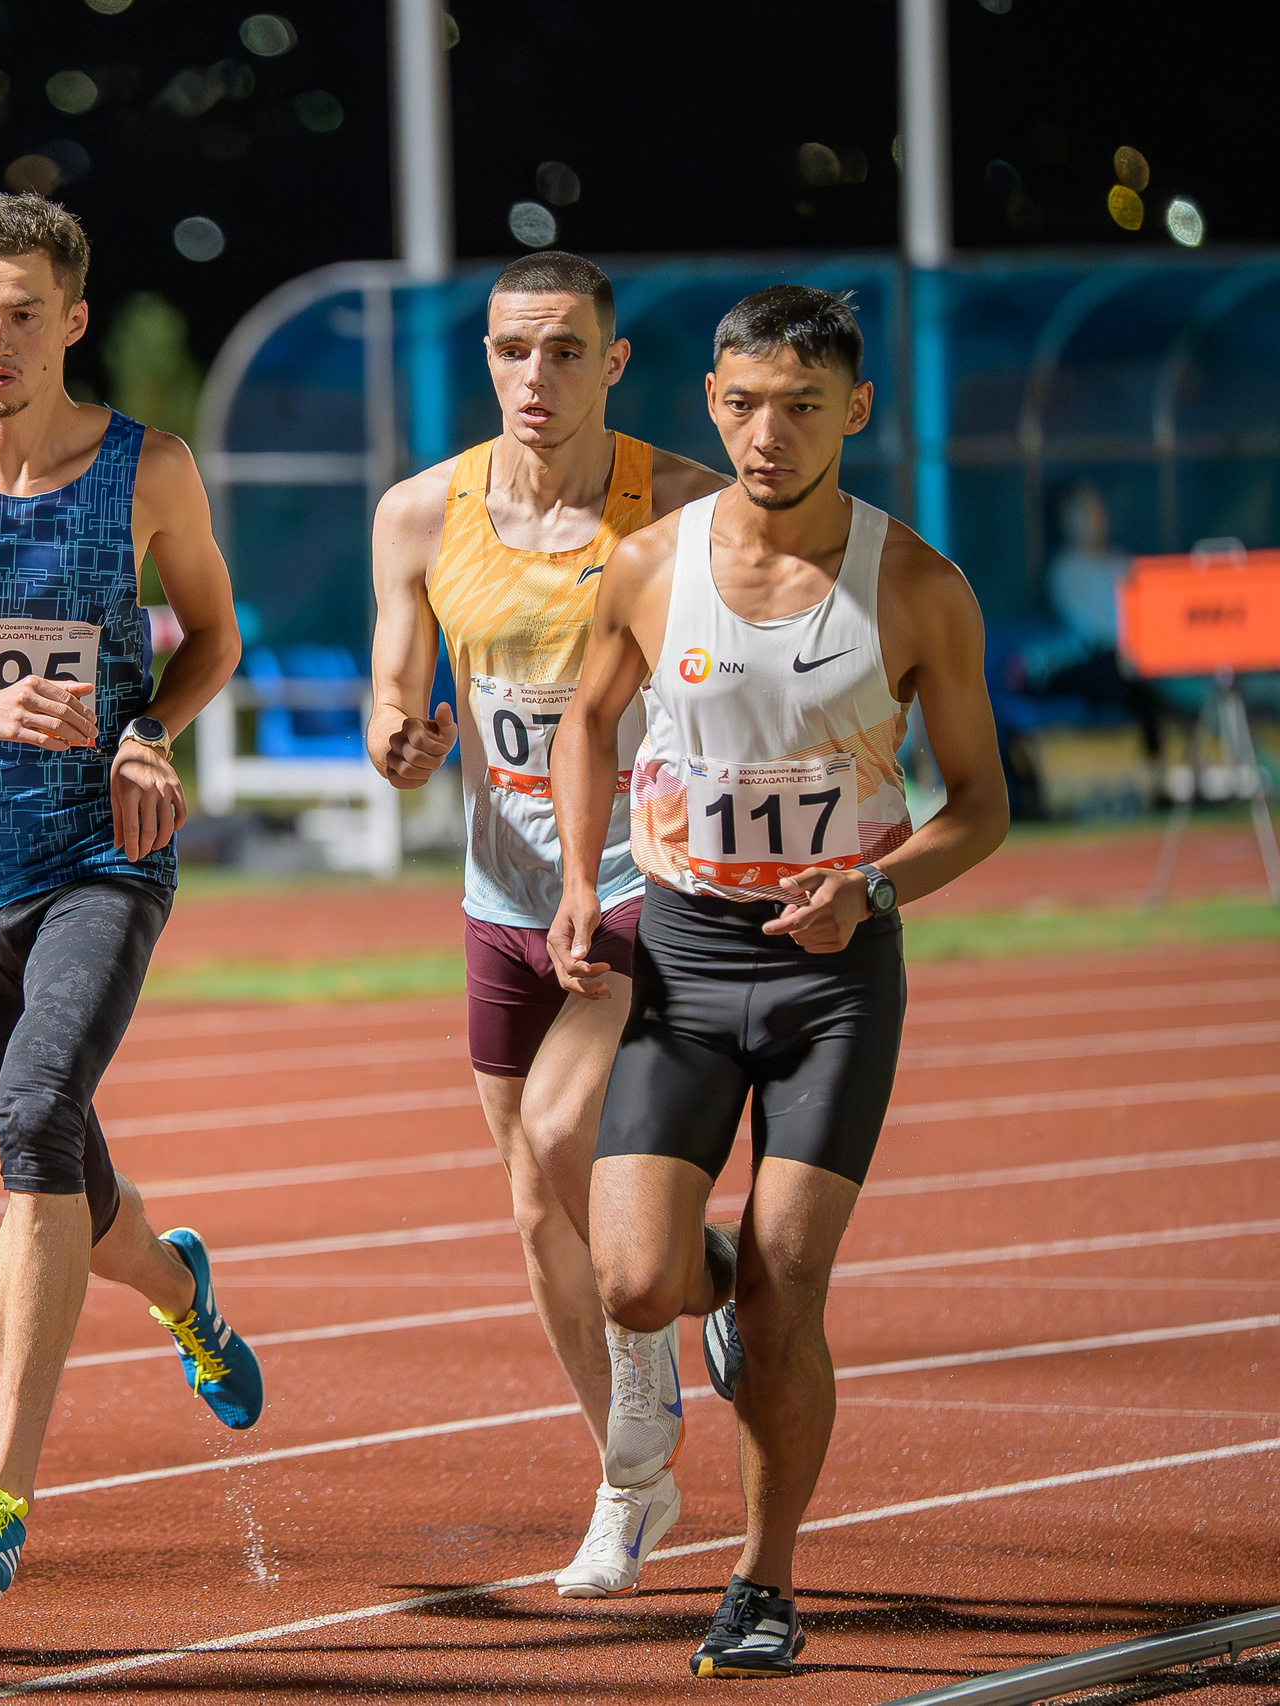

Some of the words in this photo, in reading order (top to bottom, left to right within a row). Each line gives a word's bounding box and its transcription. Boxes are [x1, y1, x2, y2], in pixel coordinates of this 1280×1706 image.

[718, 661, 745, 674] NN
[758, 767, 789, 775] Qosanov
[790, 764, 822, 773] Memorial
[738, 773, 822, 785] #QAZAQATHLETICS
[705, 786, 842, 855] 117
